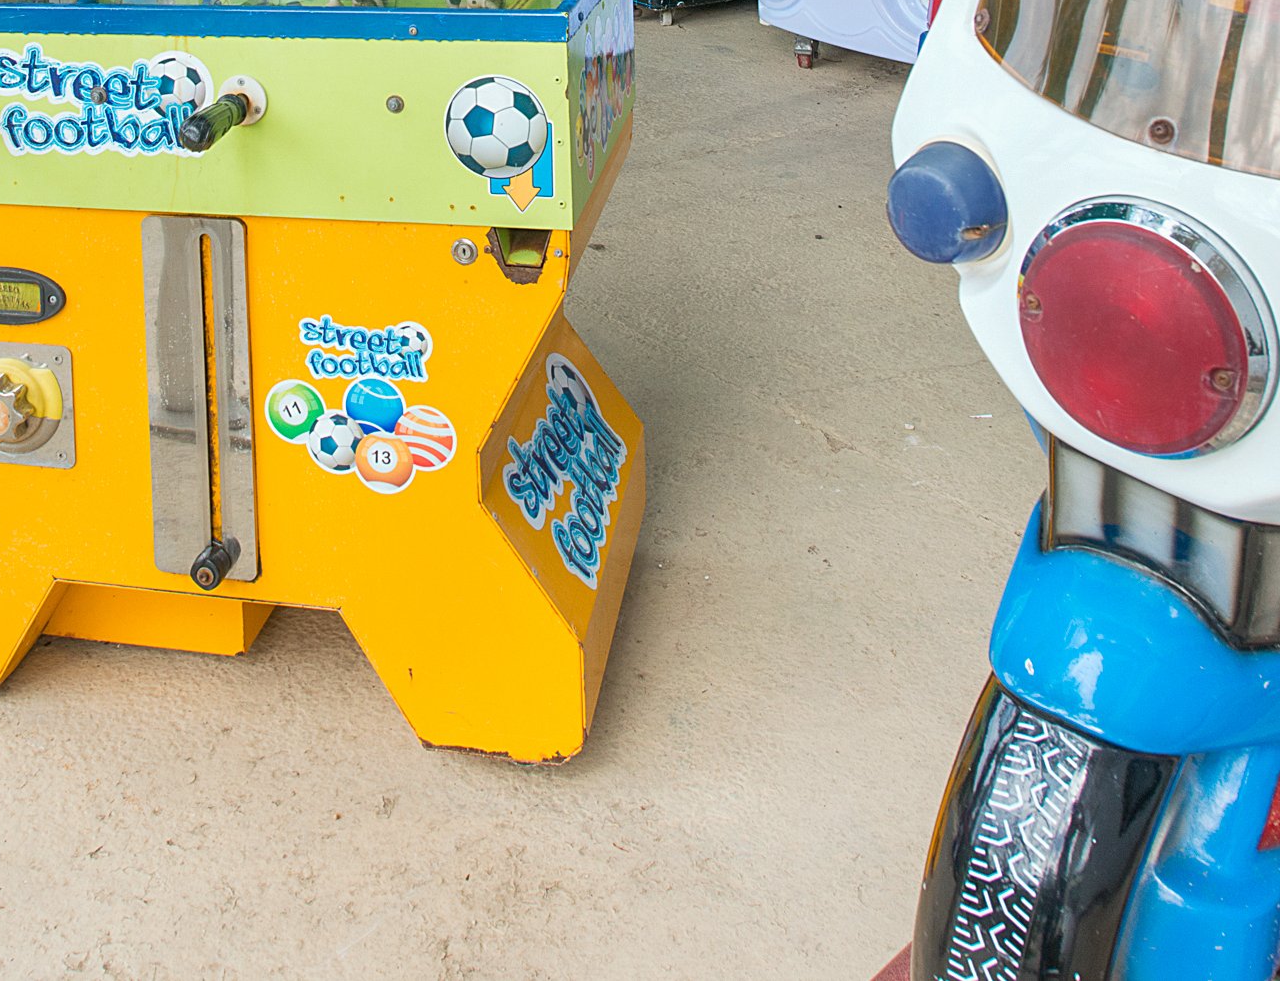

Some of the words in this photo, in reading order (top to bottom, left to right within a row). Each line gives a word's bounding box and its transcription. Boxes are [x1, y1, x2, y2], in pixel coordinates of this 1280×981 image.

[1, 104, 196, 154] footbal
[303, 318, 402, 356] street
[308, 350, 424, 378] football
[282, 401, 302, 418] 11
[371, 450, 391, 465] 13
[508, 386, 585, 520] street
[553, 406, 623, 580] football
